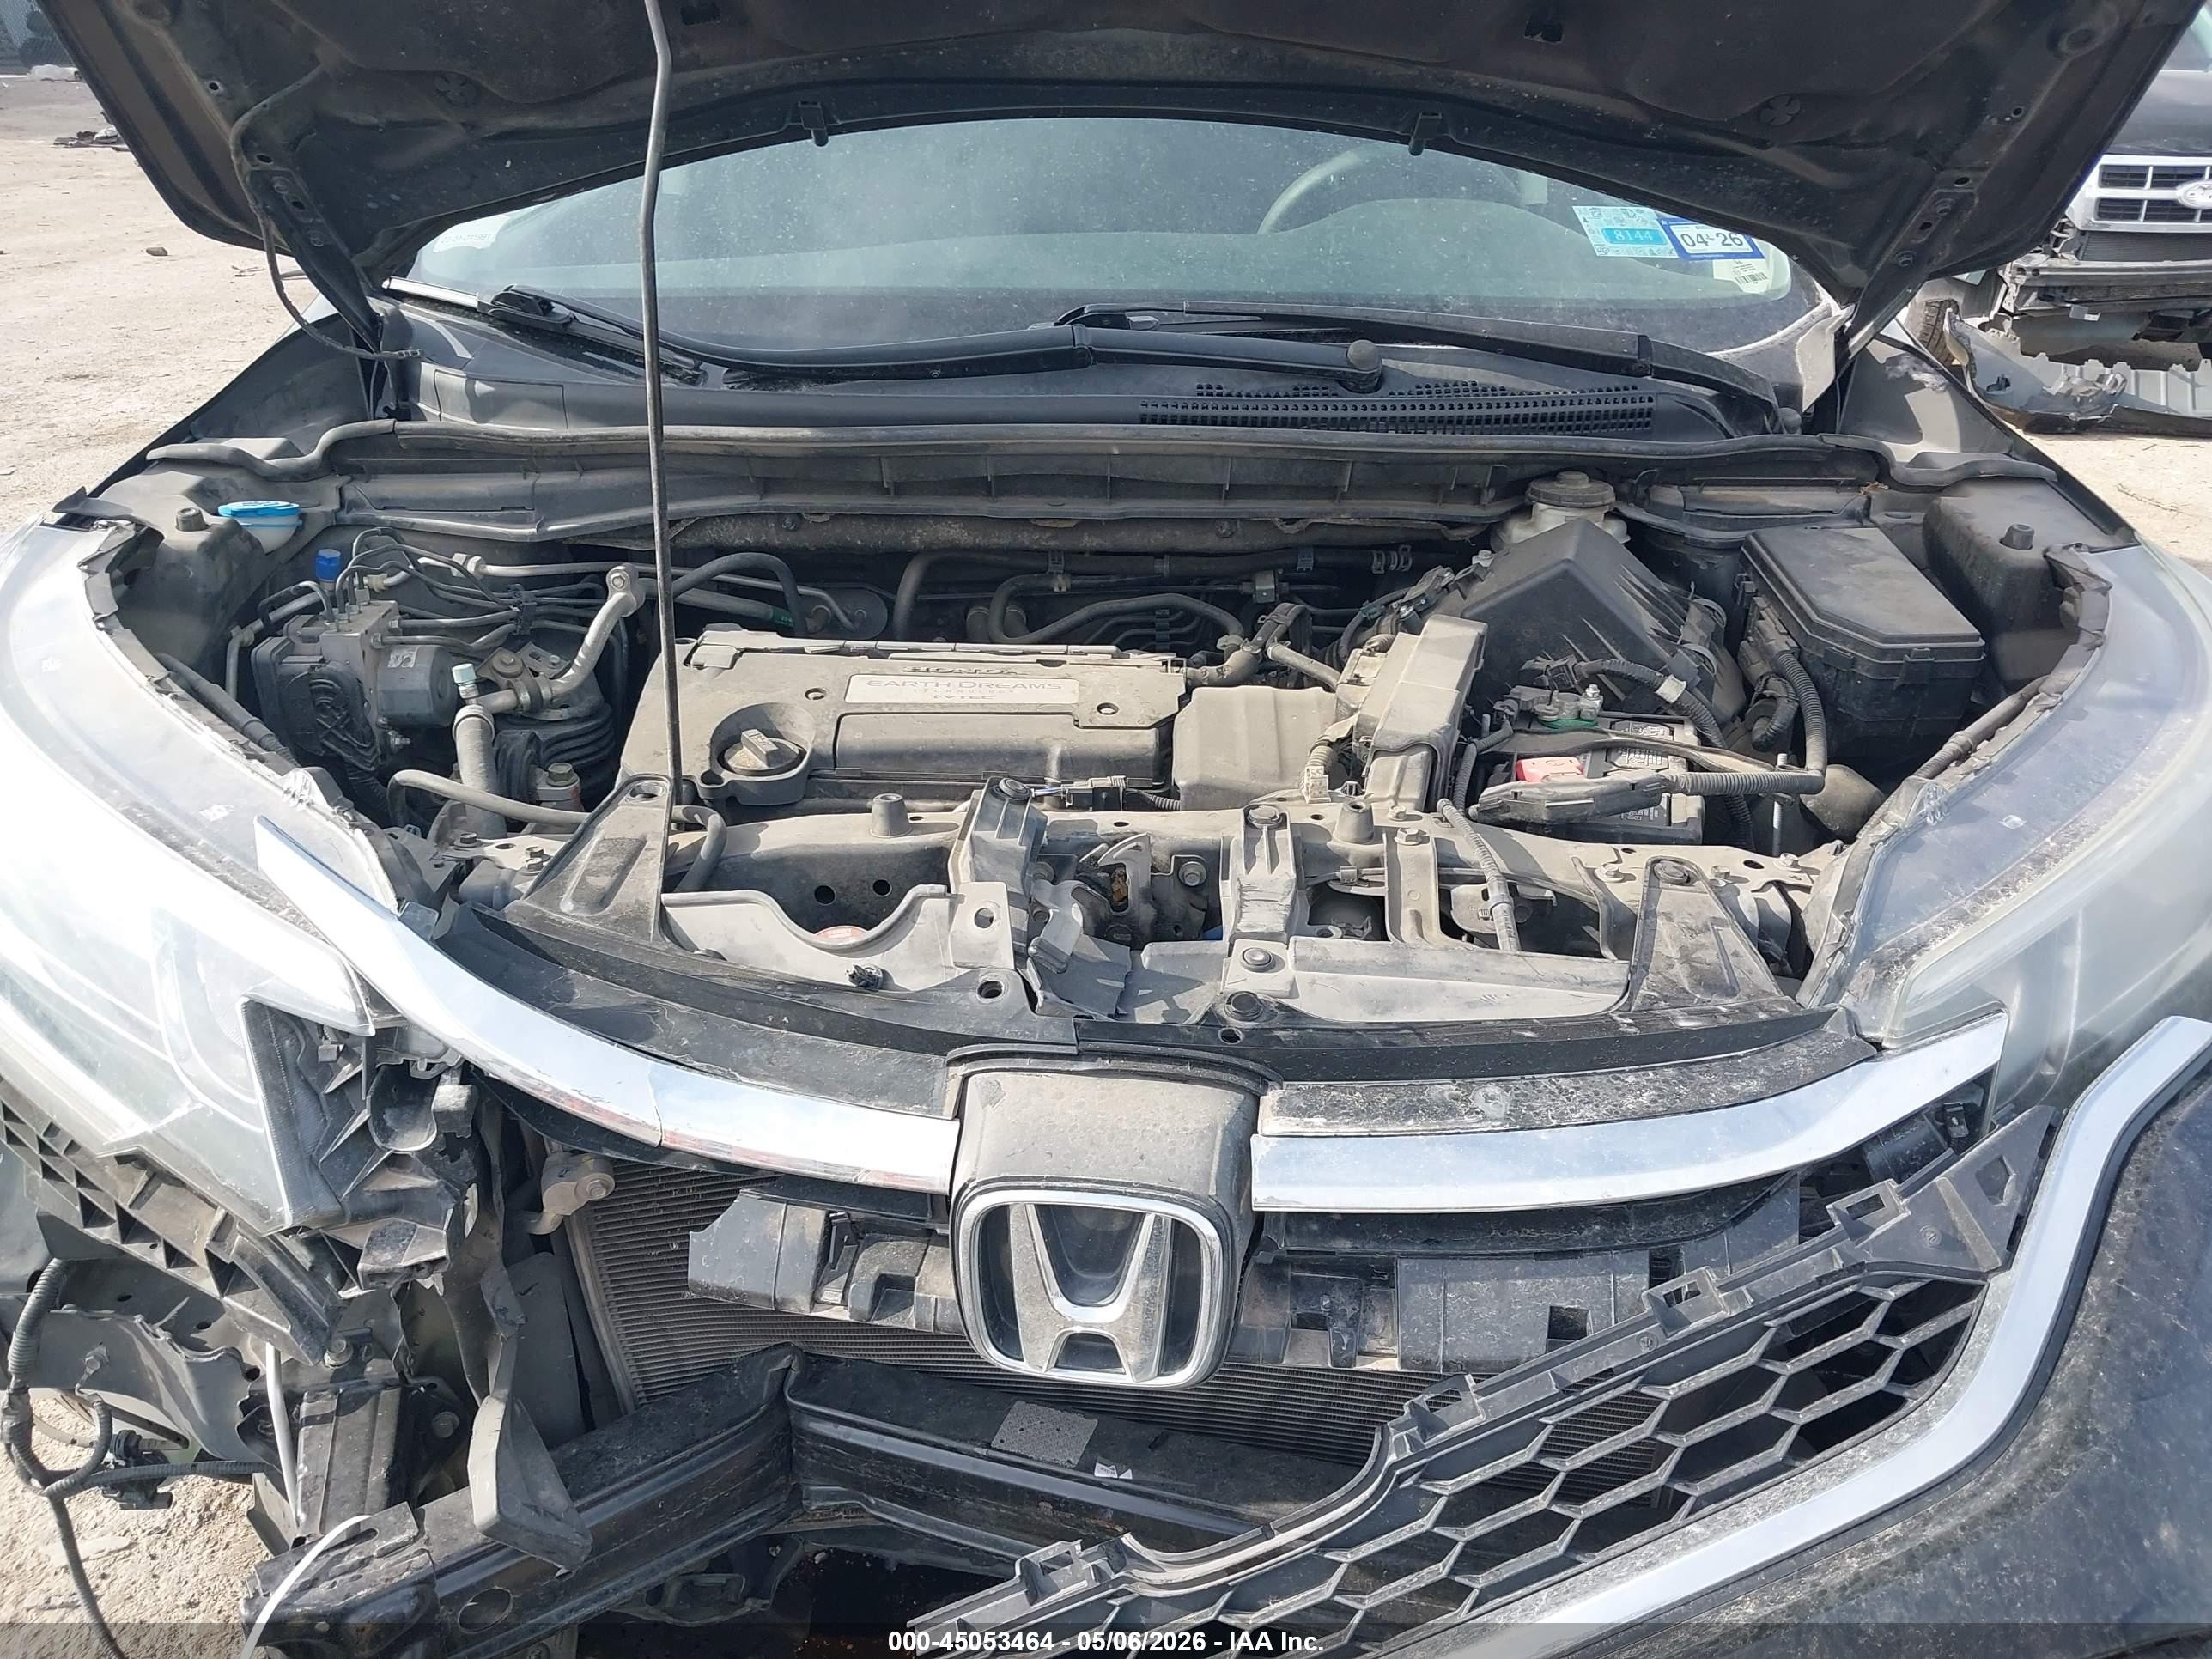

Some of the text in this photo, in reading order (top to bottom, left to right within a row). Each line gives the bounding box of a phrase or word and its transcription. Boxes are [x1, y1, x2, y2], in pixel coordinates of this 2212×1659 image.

[1614, 229, 1654, 241] 8144
[1680, 232, 1744, 247] 04 26
